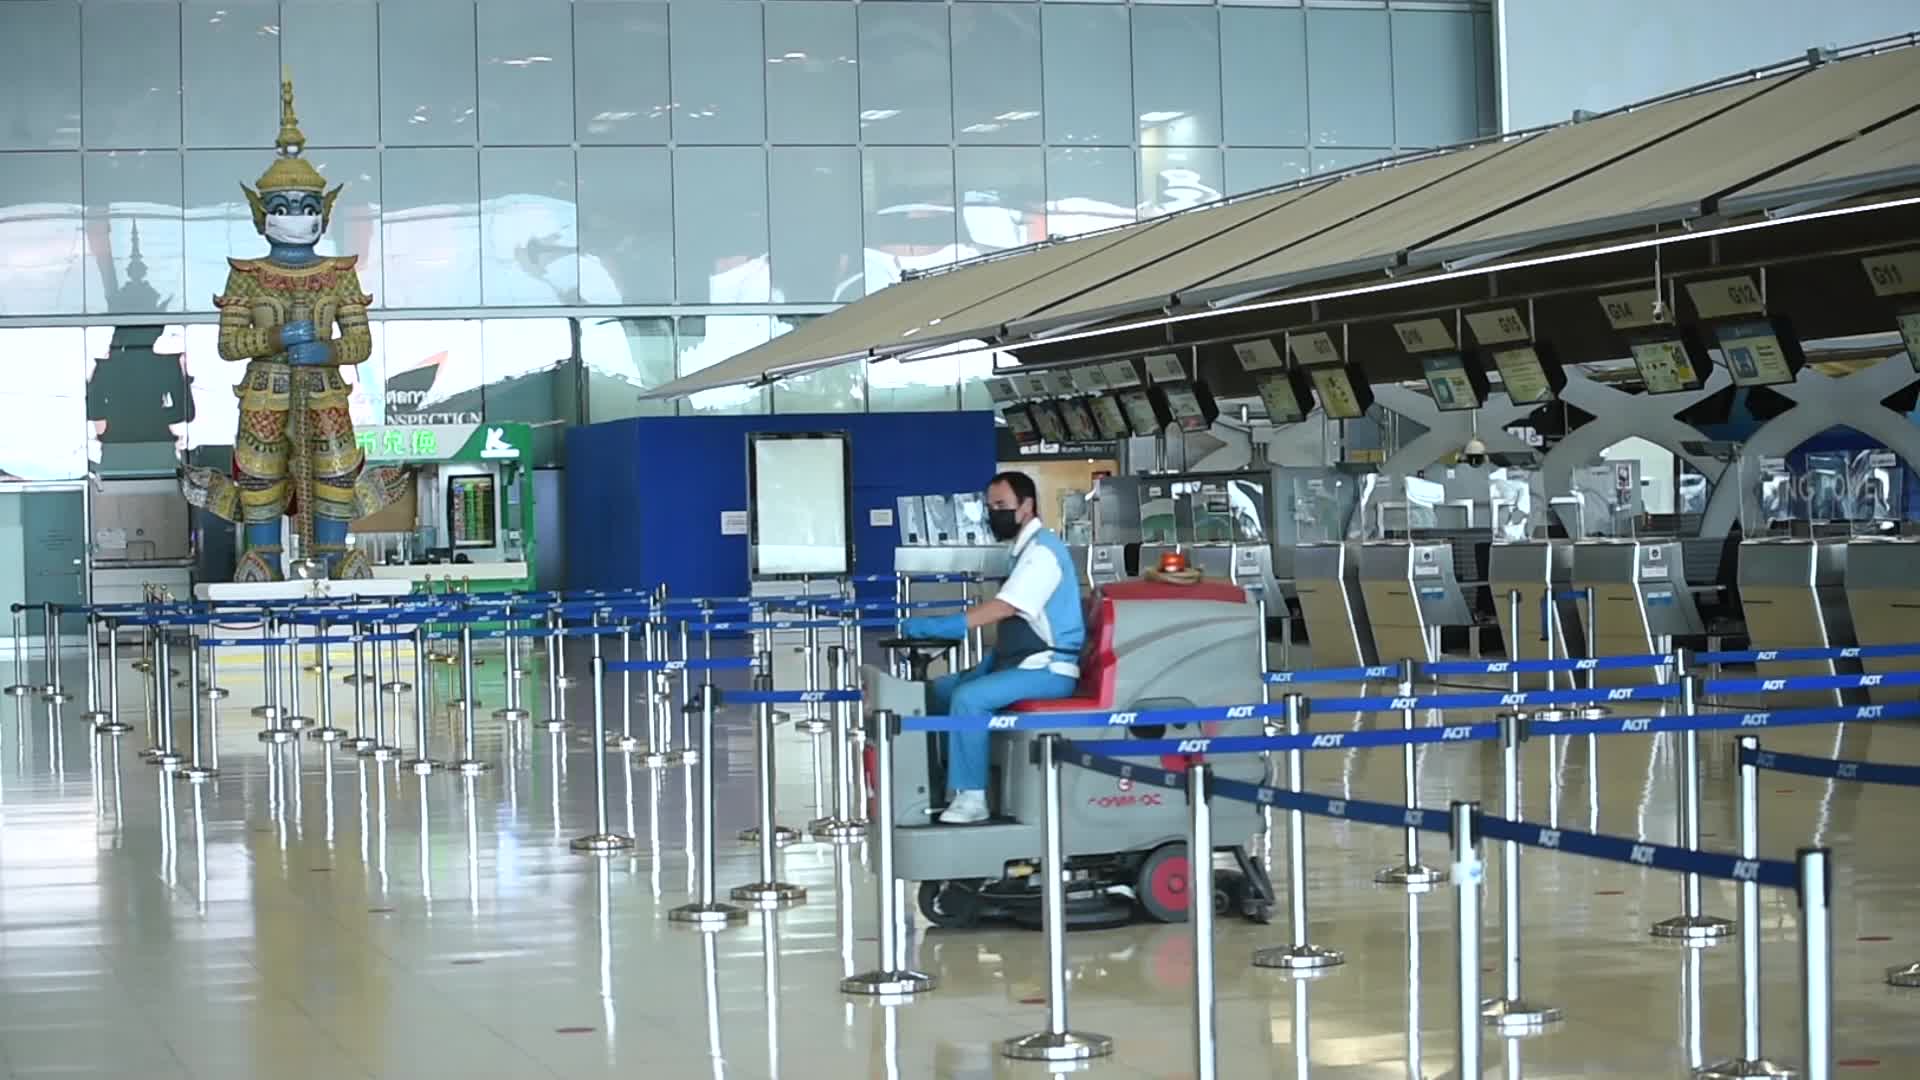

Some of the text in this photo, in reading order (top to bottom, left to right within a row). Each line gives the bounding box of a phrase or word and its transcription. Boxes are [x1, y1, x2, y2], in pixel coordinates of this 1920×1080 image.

[1872, 264, 1902, 285] G11
[386, 412, 483, 425] NSPECTION
[1757, 652, 1777, 660] AOT
[1840, 649, 1859, 657] AOT
[1487, 663, 1509, 671] AOT
[1576, 659, 1598, 668] AOT
[1270, 673, 1293, 682] AOT
[1366, 667, 1387, 676] AOT
[1762, 680, 1784, 690] AOT
[1860, 675, 1882, 686] AOT
[800, 691, 824, 701] AOT
[1501, 694, 1526, 705] AOT
[1609, 689, 1633, 699] AOT
[1391, 698, 1417, 709] AOT
[1227, 706, 1255, 718] AOT
[1857, 706, 1883, 718] AOT
[989, 716, 1017, 728] AOT
[1109, 713, 1138, 725] AOT
[1622, 719, 1652, 731] AOT
[1742, 714, 1770, 726] AOT
[1443, 727, 1471, 740] AOT
[1178, 740, 1209, 753] AOT
[1312, 734, 1343, 748] AOT
[1538, 829, 1561, 847] AOT
[1631, 845, 1655, 864] AOT
[1733, 861, 1759, 879] AOT
